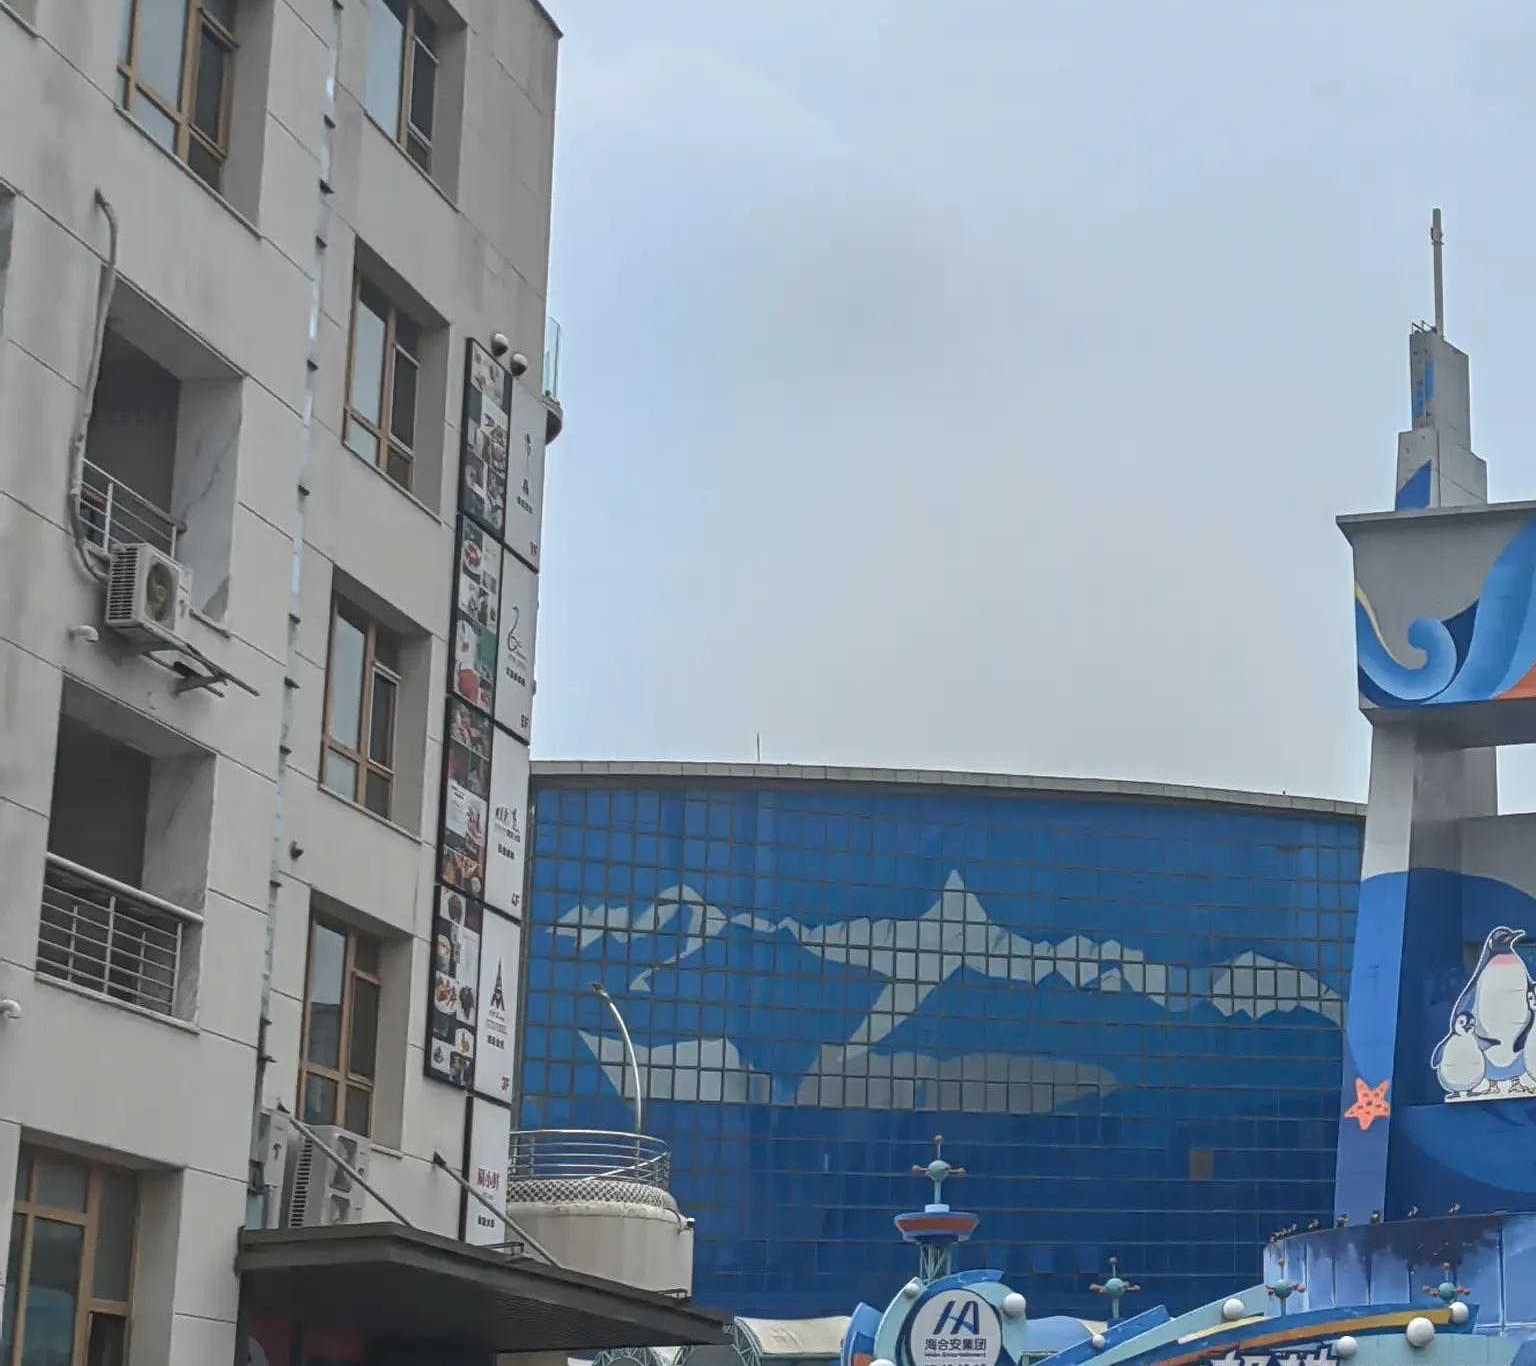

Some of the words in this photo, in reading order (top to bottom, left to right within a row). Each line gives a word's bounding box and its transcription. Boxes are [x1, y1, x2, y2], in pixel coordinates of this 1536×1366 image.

[924, 1338, 987, 1352] 海合安集团
